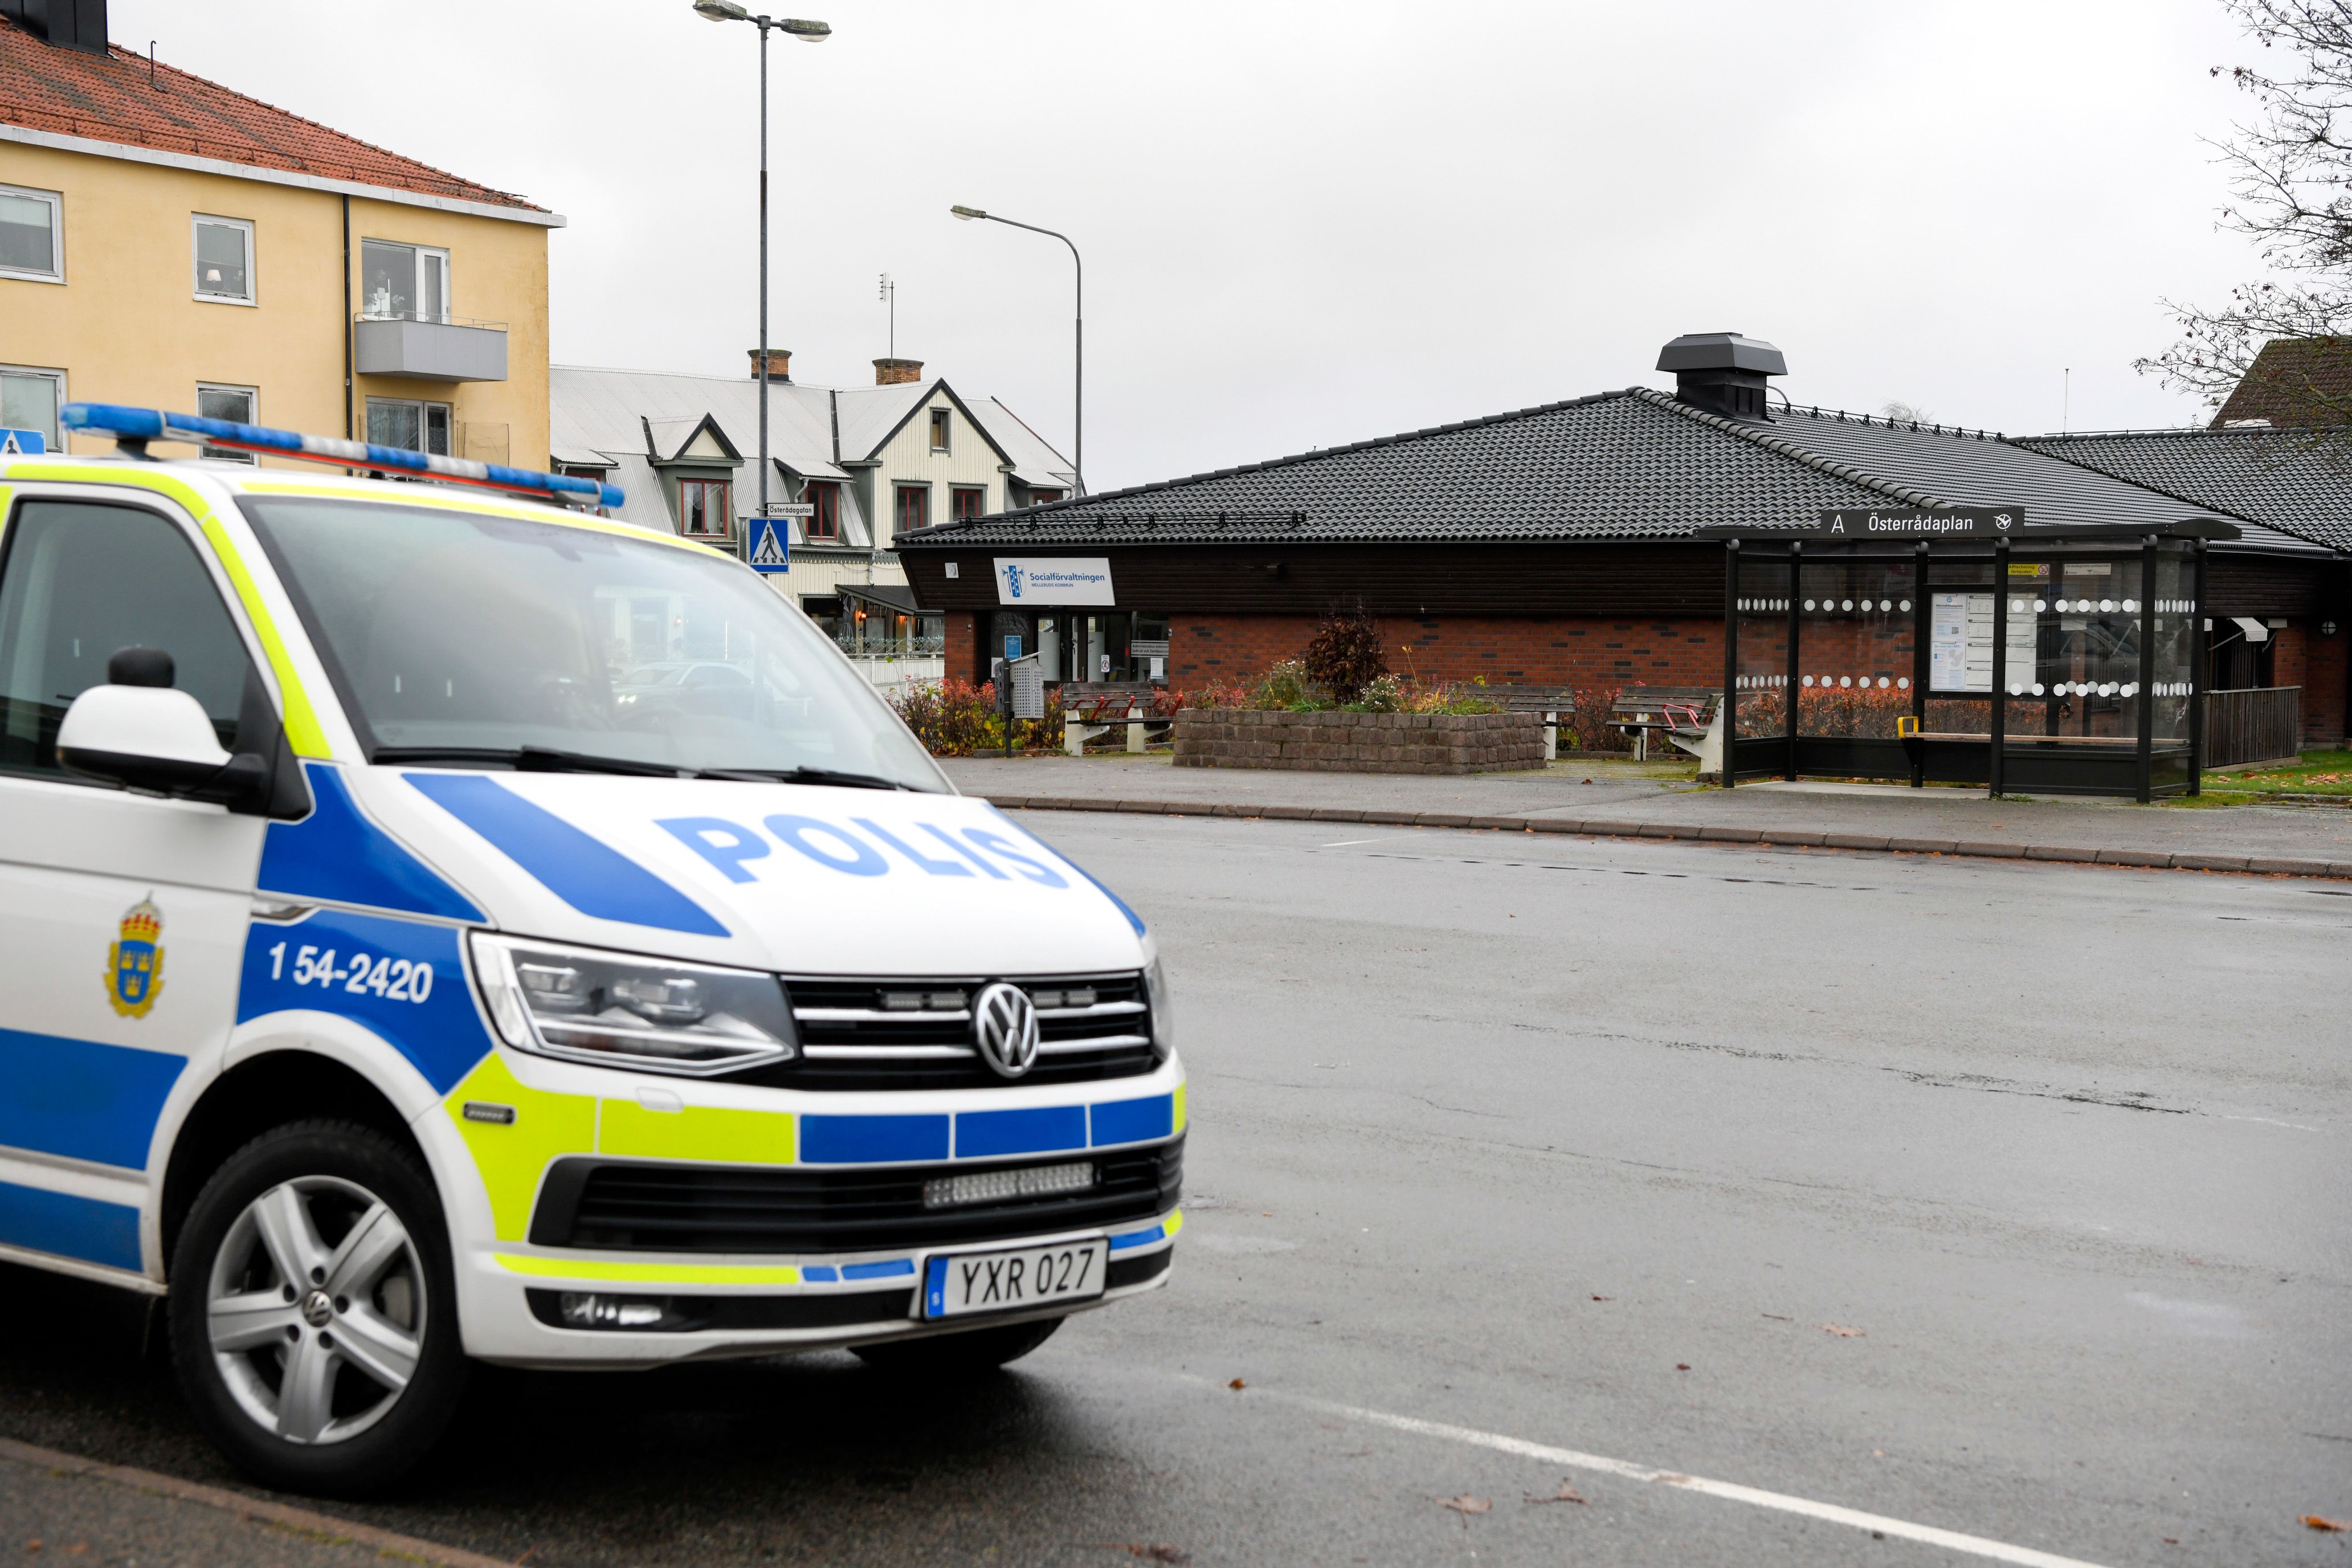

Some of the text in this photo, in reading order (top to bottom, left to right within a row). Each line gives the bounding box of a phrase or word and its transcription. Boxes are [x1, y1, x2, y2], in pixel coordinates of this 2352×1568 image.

[770, 505, 812, 514] Österådagatan
[1831, 512, 1973, 533] A Österrådaplan
[1030, 573, 1105, 583] Socialförvaltningen
[653, 813, 1069, 889] POLIS
[293, 945, 433, 1004] 54-2420
[962, 1257, 1026, 1305] YXR
[1036, 1247, 1094, 1295] 027
